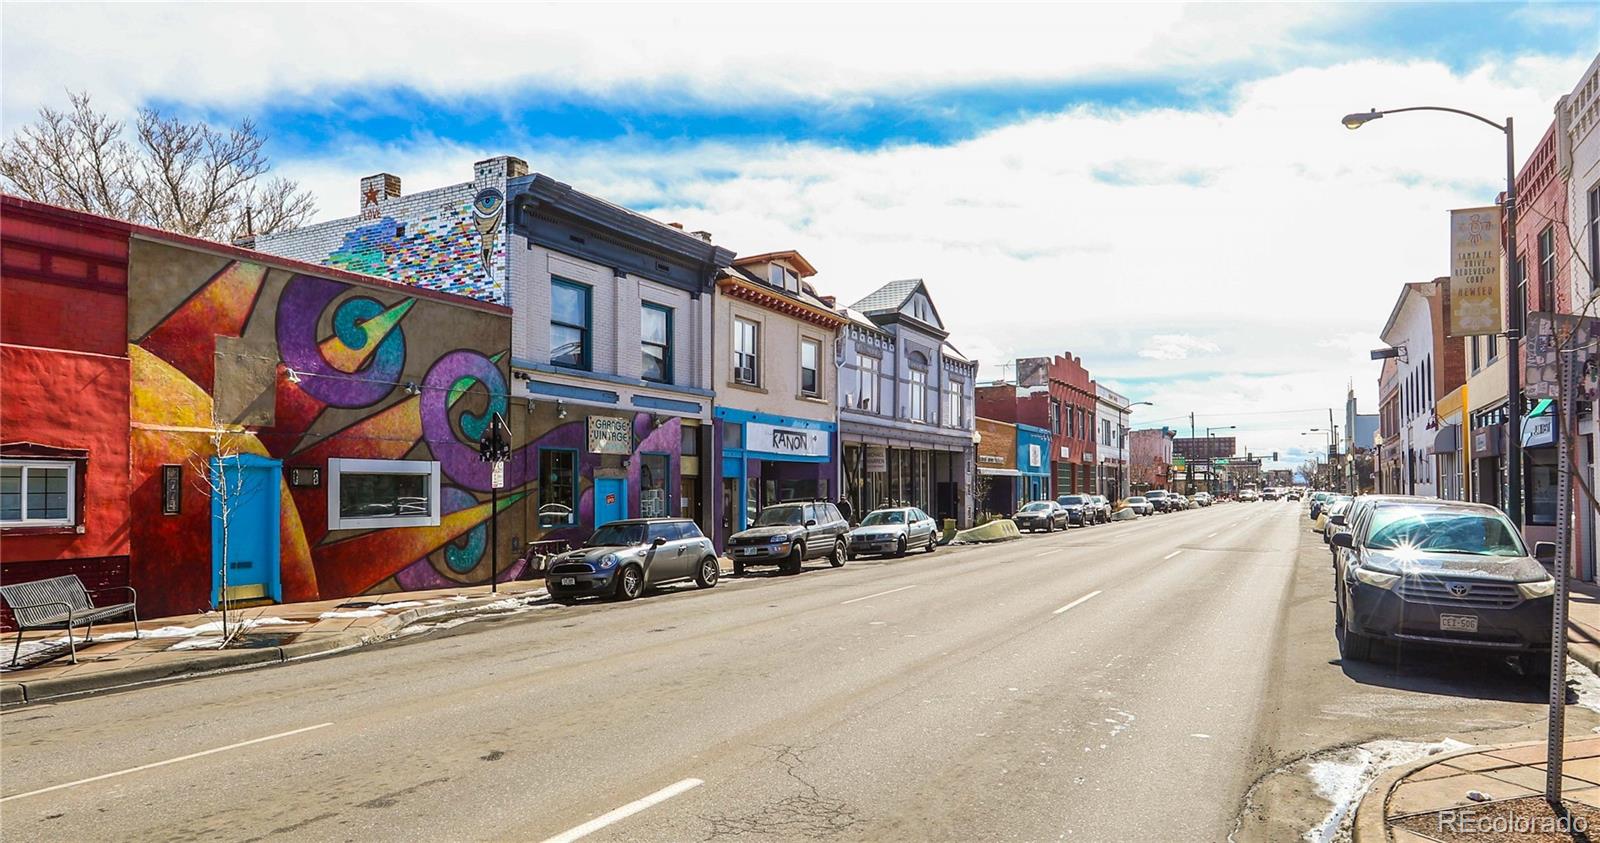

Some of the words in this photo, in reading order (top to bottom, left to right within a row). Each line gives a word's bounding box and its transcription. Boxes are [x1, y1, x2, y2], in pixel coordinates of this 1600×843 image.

[1458, 252, 1480, 260] SANTA
[1455, 268, 1496, 277] REDEVELOP
[1466, 276, 1484, 284] CORP
[596, 420, 627, 431] GARAGE
[593, 430, 628, 442] VINTAGE
[772, 429, 808, 451] KANON
